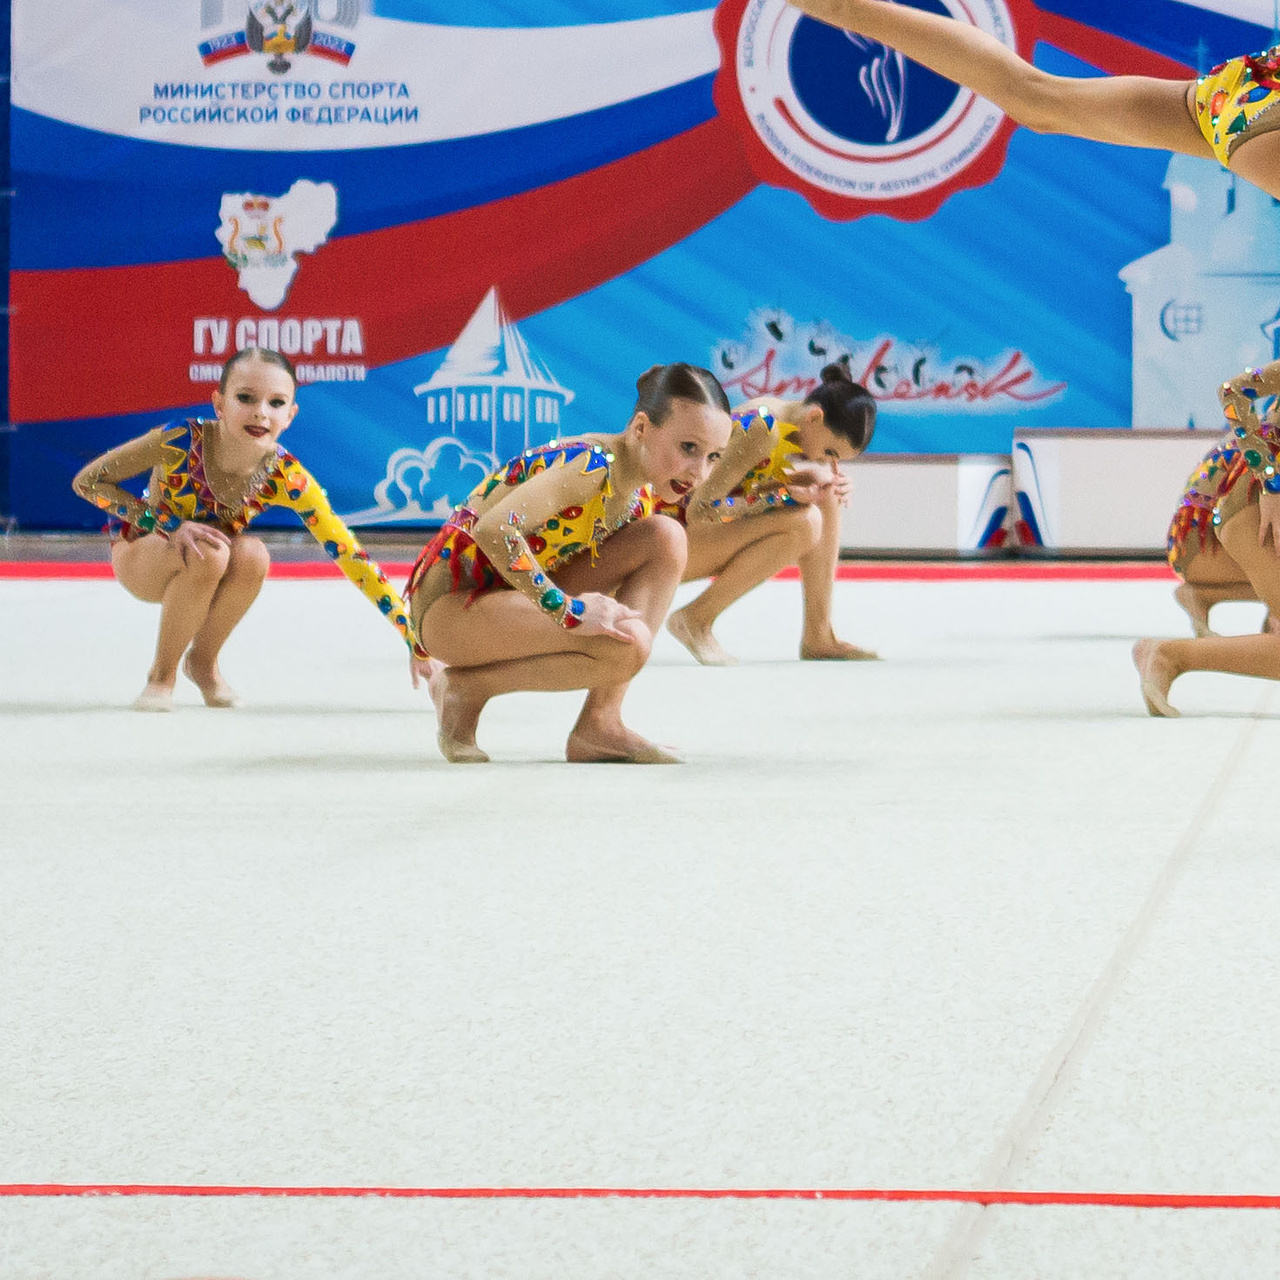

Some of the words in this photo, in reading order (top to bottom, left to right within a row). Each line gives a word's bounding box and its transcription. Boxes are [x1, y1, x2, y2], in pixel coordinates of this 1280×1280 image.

[153, 82, 321, 100] МИНИСТЕРСТВО
[328, 82, 410, 99] СПОРТА
[139, 100, 278, 124] РОССИЙСКОЙ
[285, 106, 419, 125] ФЕДЕРАЦИИ
[858, 180, 875, 192] OF
[193, 319, 228, 355] ГУ
[235, 319, 363, 355] СПОРТА
